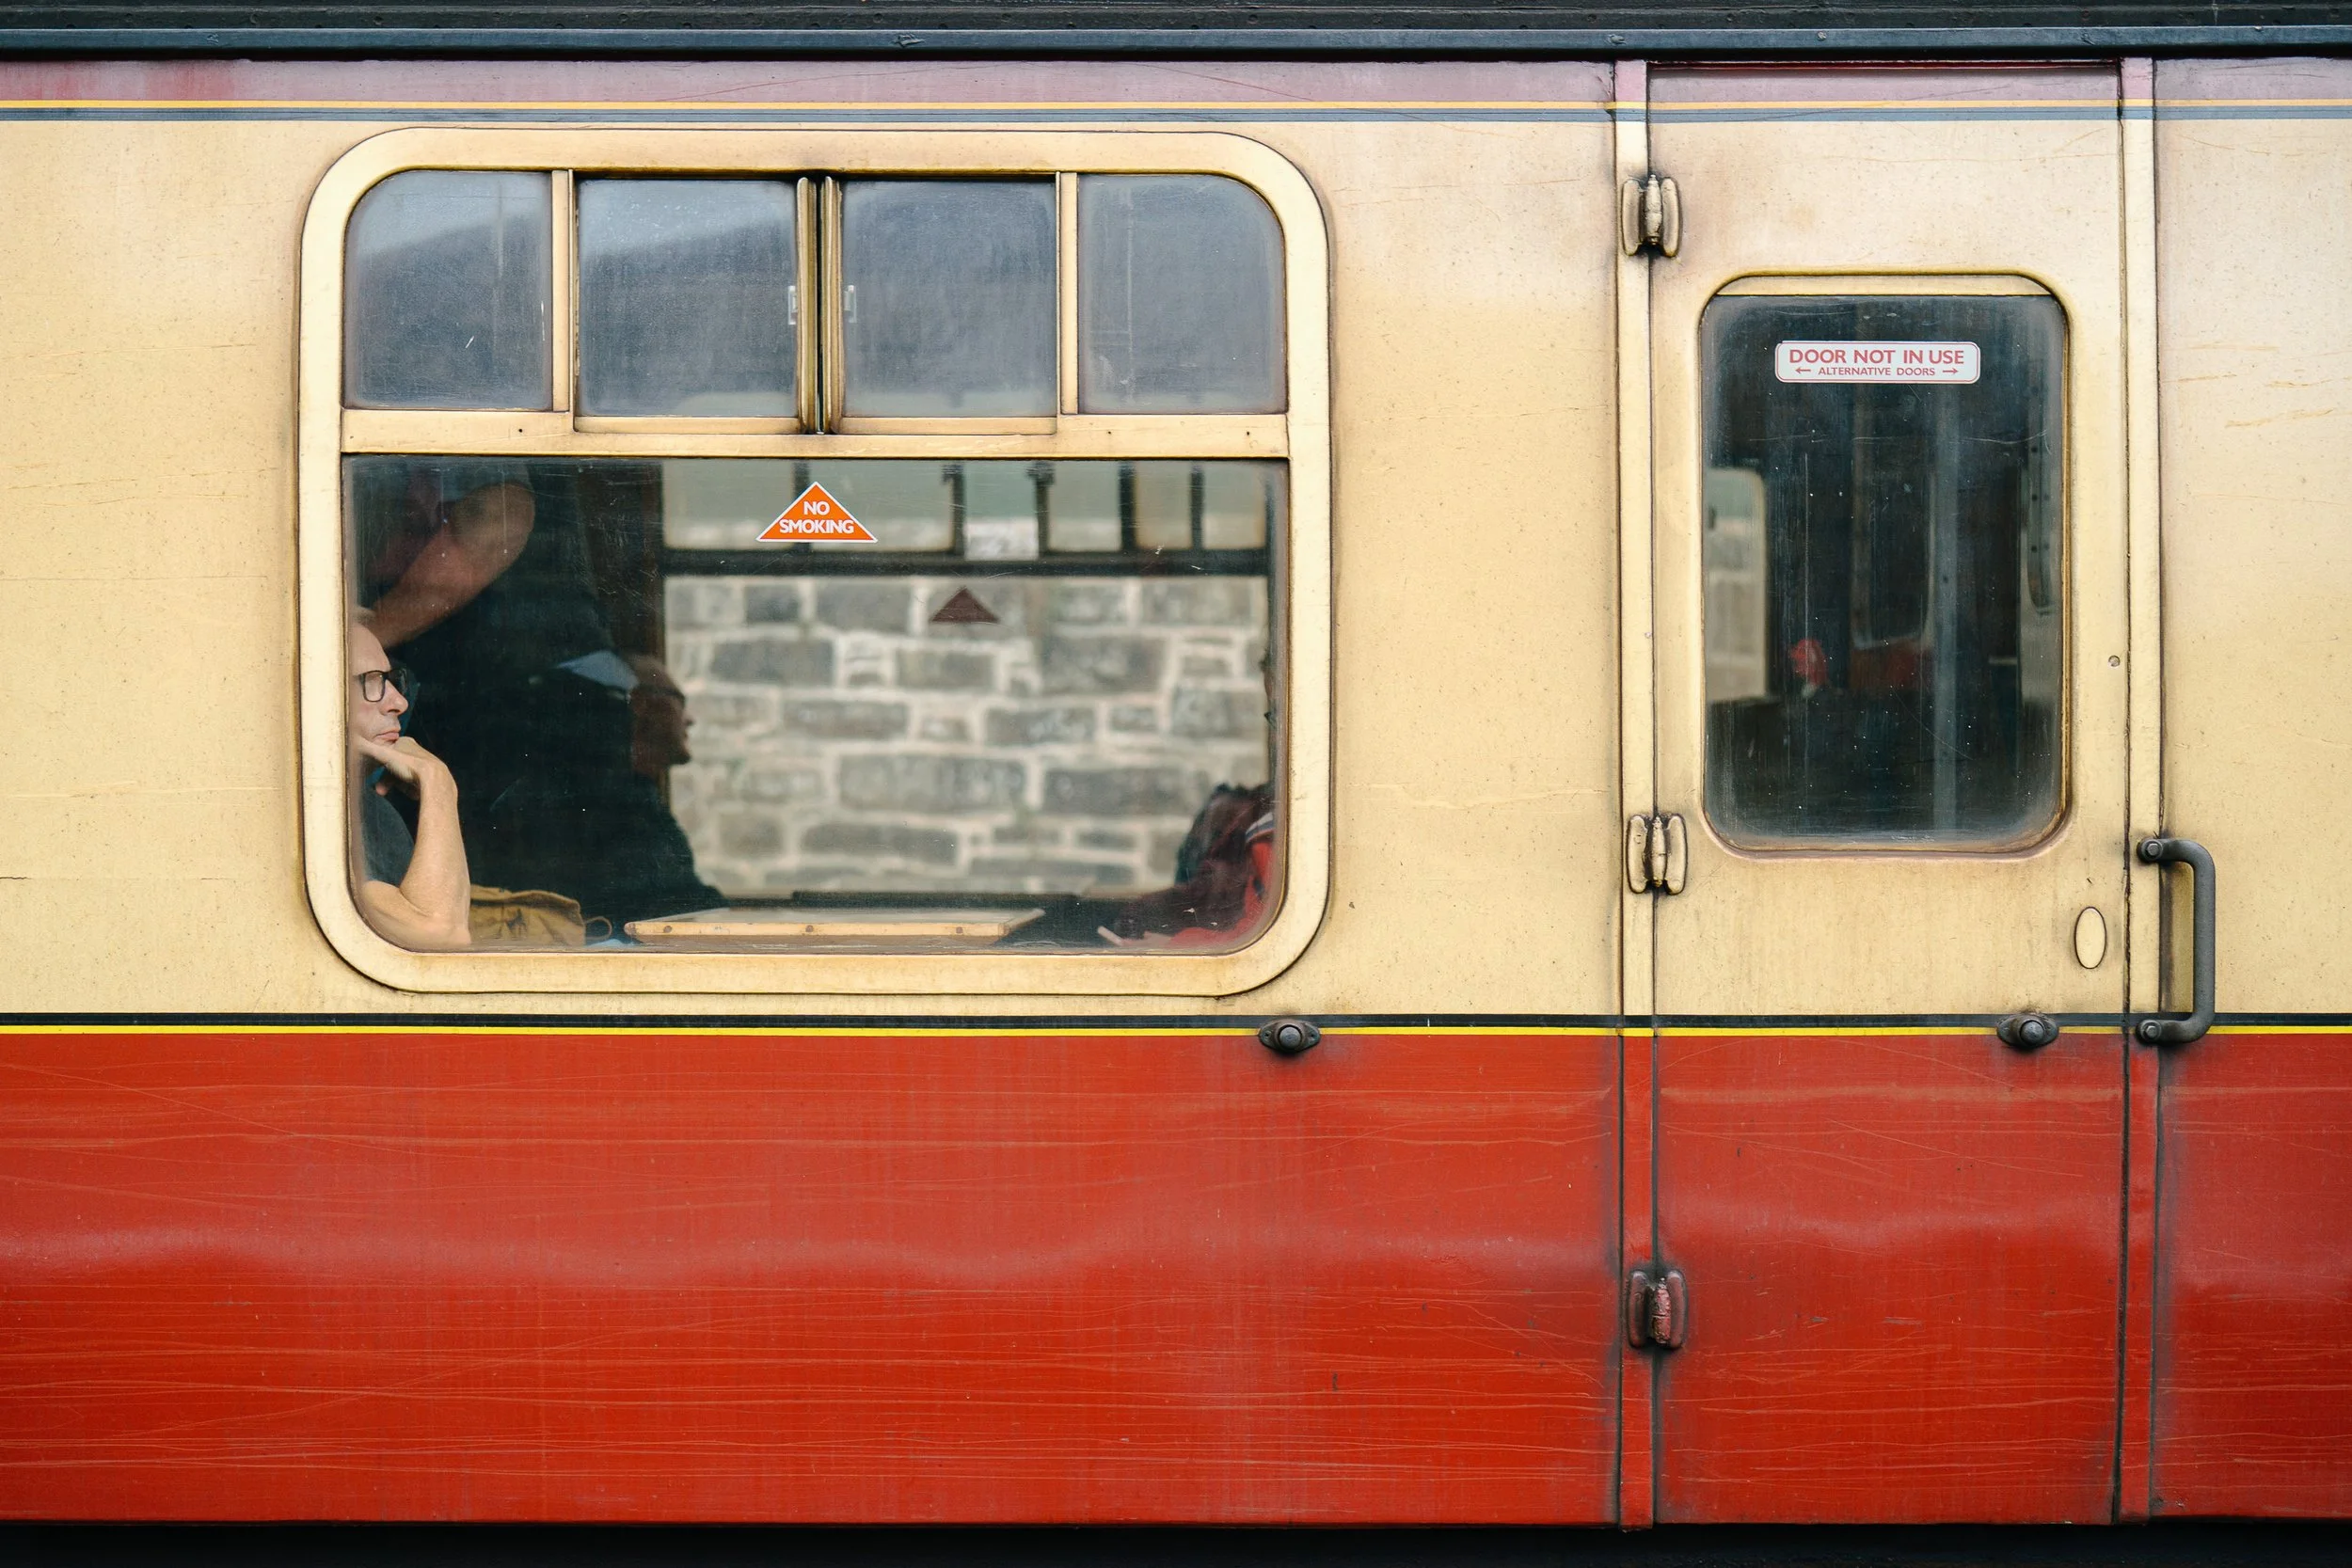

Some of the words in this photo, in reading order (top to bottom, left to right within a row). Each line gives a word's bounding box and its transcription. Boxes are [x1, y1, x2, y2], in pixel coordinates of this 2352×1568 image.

[1789, 349, 1846, 364] DOOR
[1853, 349, 1896, 364] NOT
[1903, 350, 1923, 364] IN
[1929, 350, 1964, 365] USE
[1818, 367, 1891, 375] ALTERNATIVE
[1897, 367, 1935, 376] DOORS
[803, 501, 831, 515] NO
[779, 519, 854, 533] SMOKING
